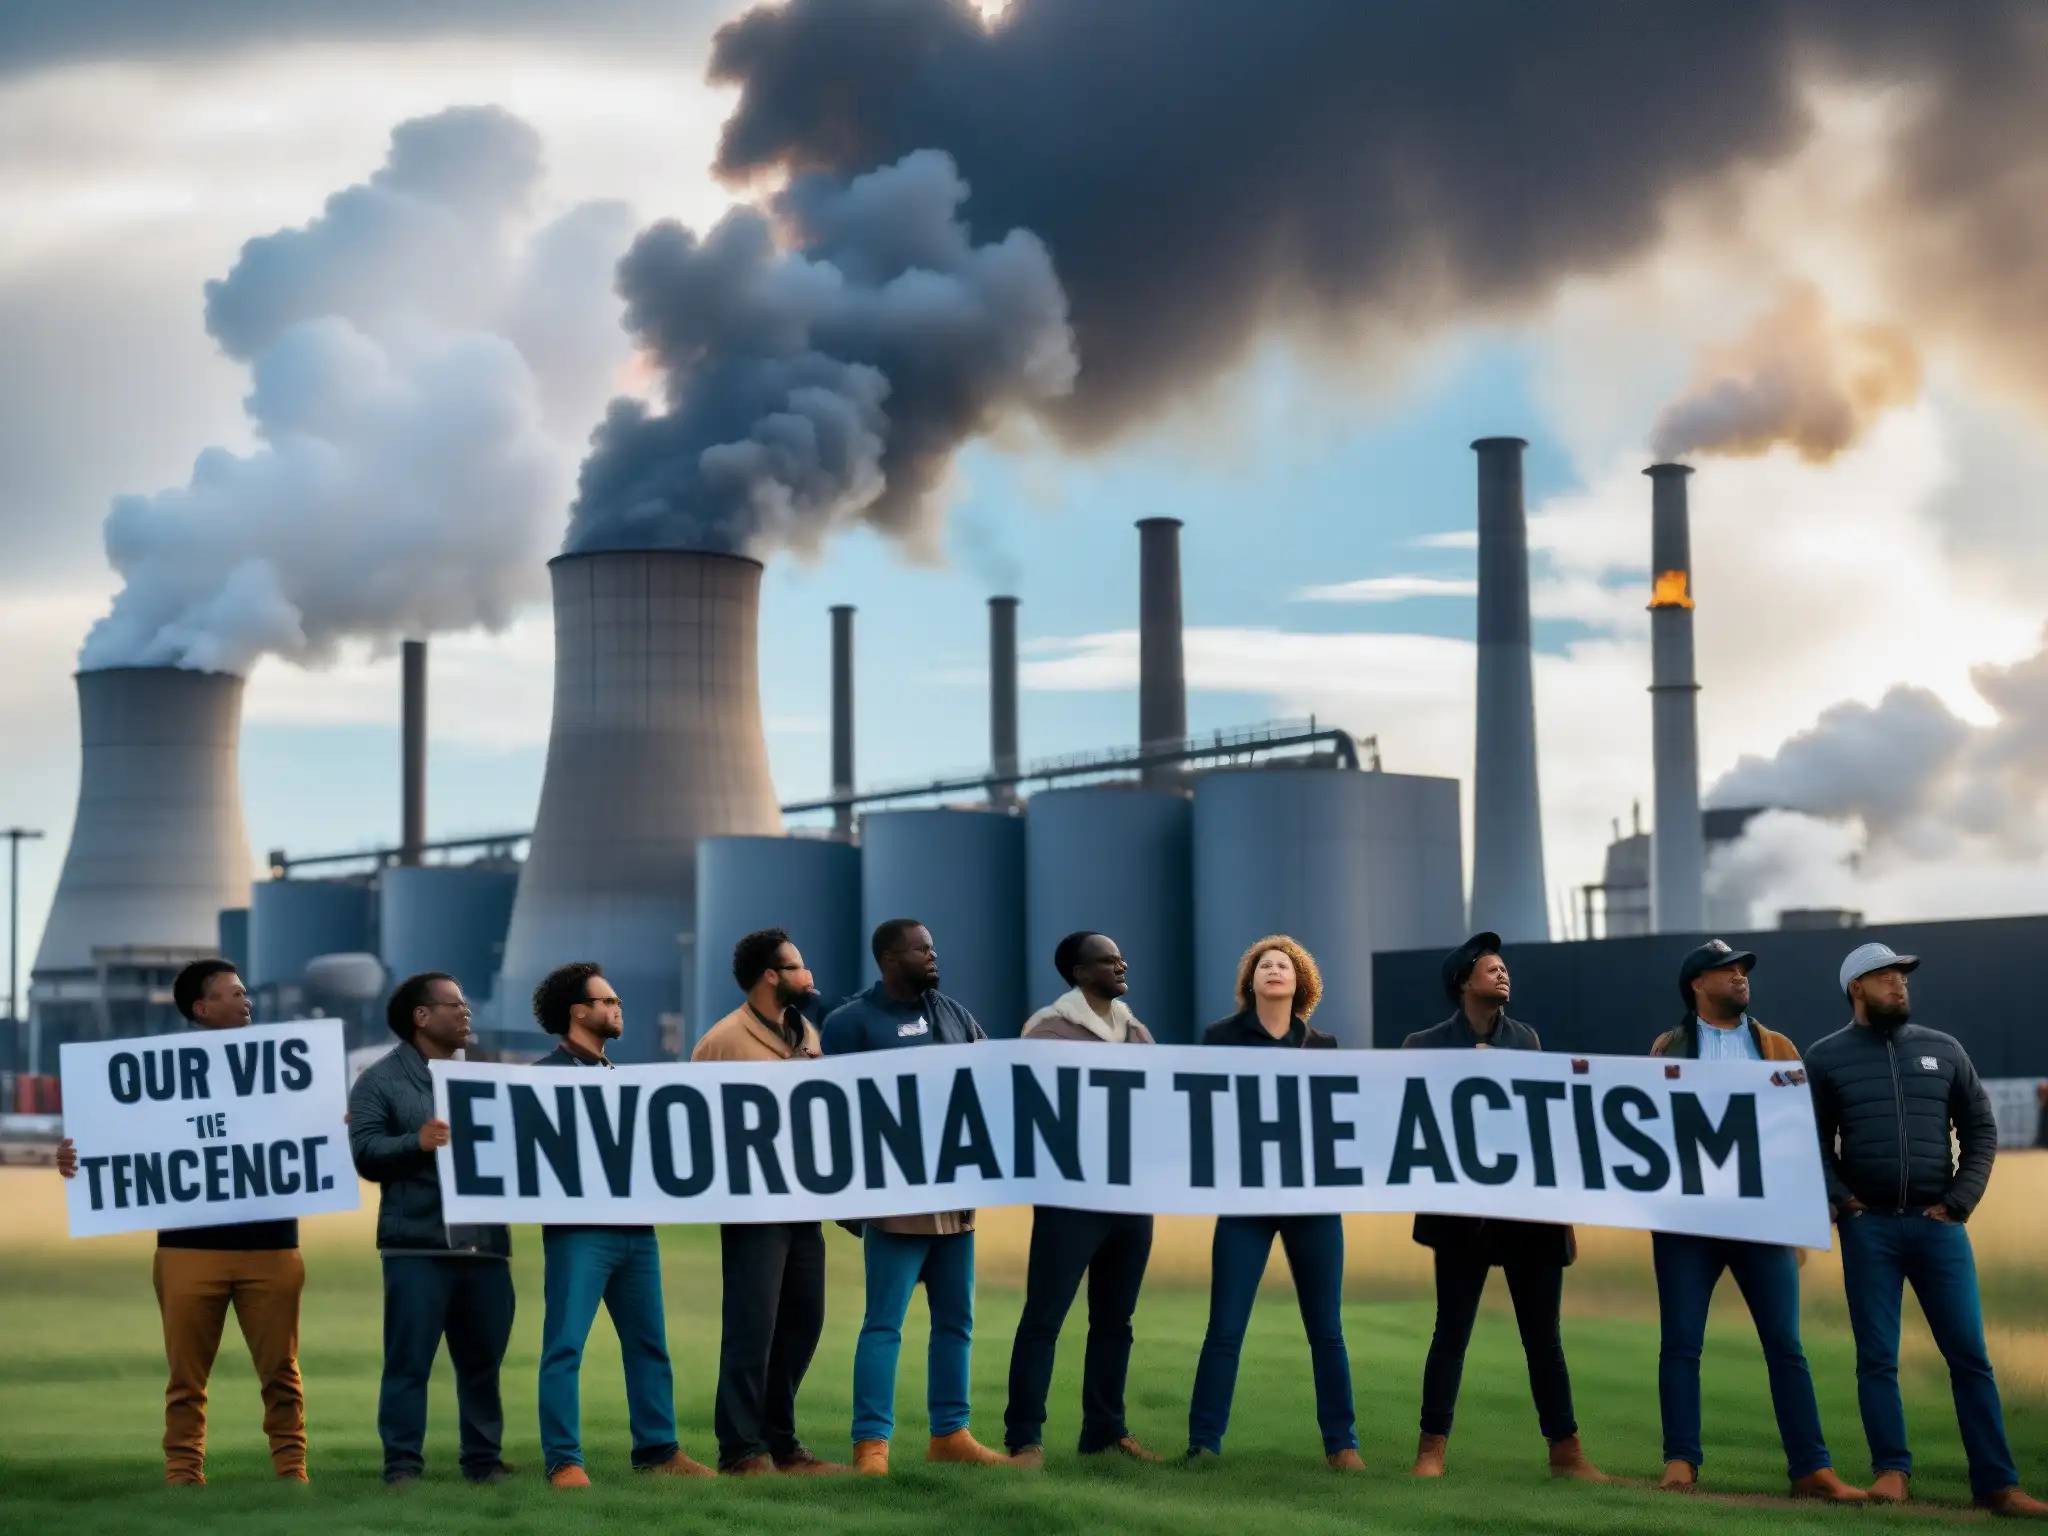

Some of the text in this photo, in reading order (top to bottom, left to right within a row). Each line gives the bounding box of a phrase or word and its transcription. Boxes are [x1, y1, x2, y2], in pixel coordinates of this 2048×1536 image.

[108, 1038, 313, 1104] OUR VIS
[446, 1064, 1764, 1198] ENVORONANT THE ACTISM
